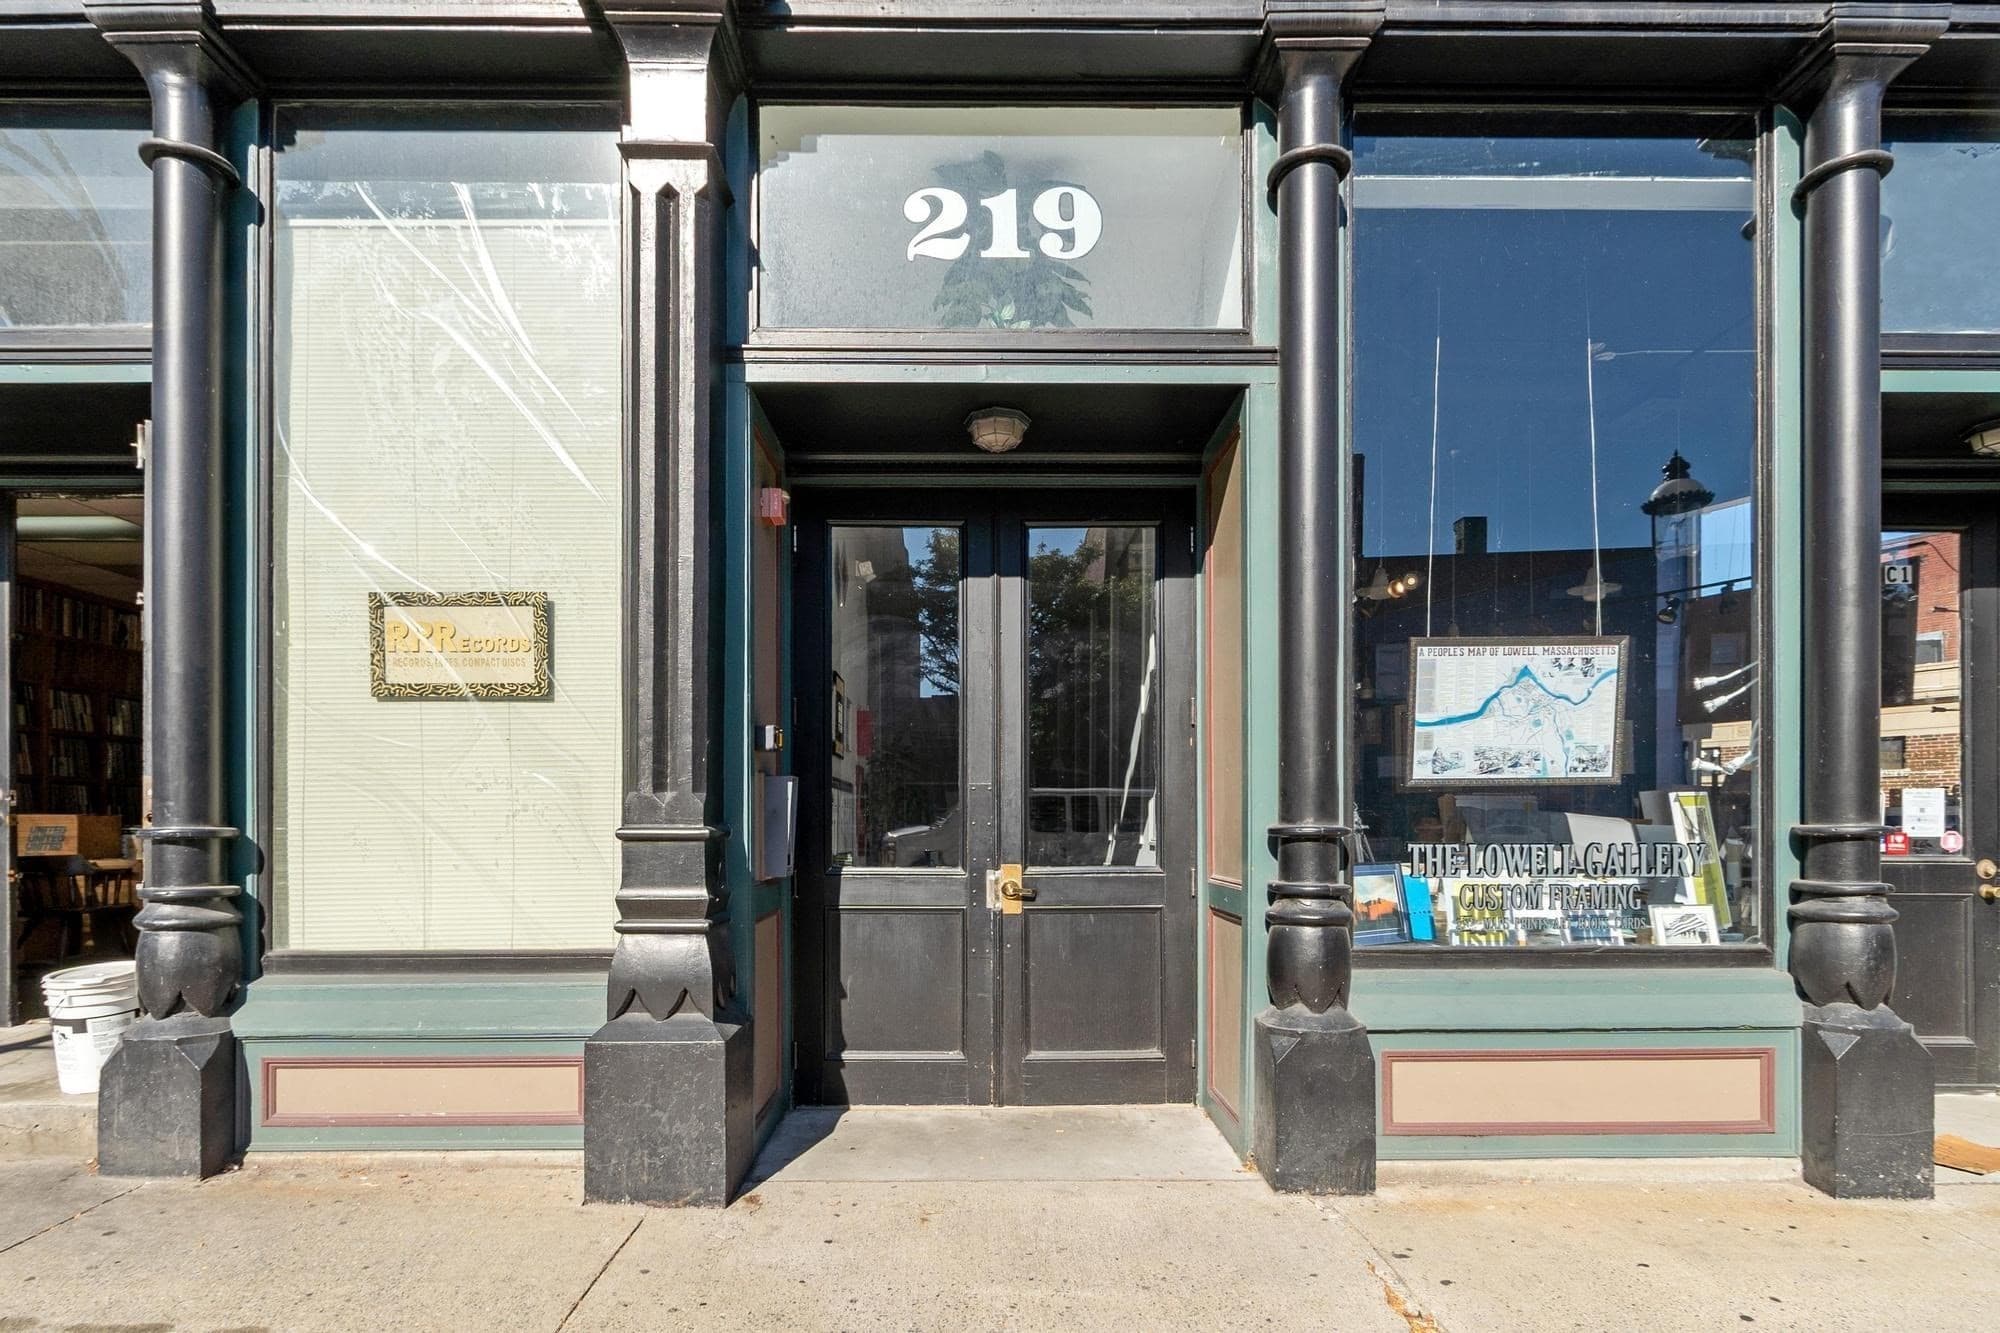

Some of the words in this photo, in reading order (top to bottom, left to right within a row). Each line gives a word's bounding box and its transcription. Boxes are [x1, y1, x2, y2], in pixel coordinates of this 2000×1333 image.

[903, 187, 1103, 261] 219
[463, 657, 500, 667] COMPACT
[502, 657, 527, 667] DISCS
[1418, 647, 1425, 657] A
[1467, 647, 1487, 656] MAP
[1489, 647, 1500, 656] OF
[1542, 646, 1617, 656] MASSACHUSETTS
[1407, 842, 1461, 878] THE
[1466, 842, 1578, 878] LOWELL
[1583, 842, 1708, 878] GALLERY
[1459, 883, 1544, 911] CUSTOM
[1549, 883, 1642, 911] FRAMING
[1514, 916, 1550, 930] PRINTS
[1615, 917, 1647, 930] CARDS
